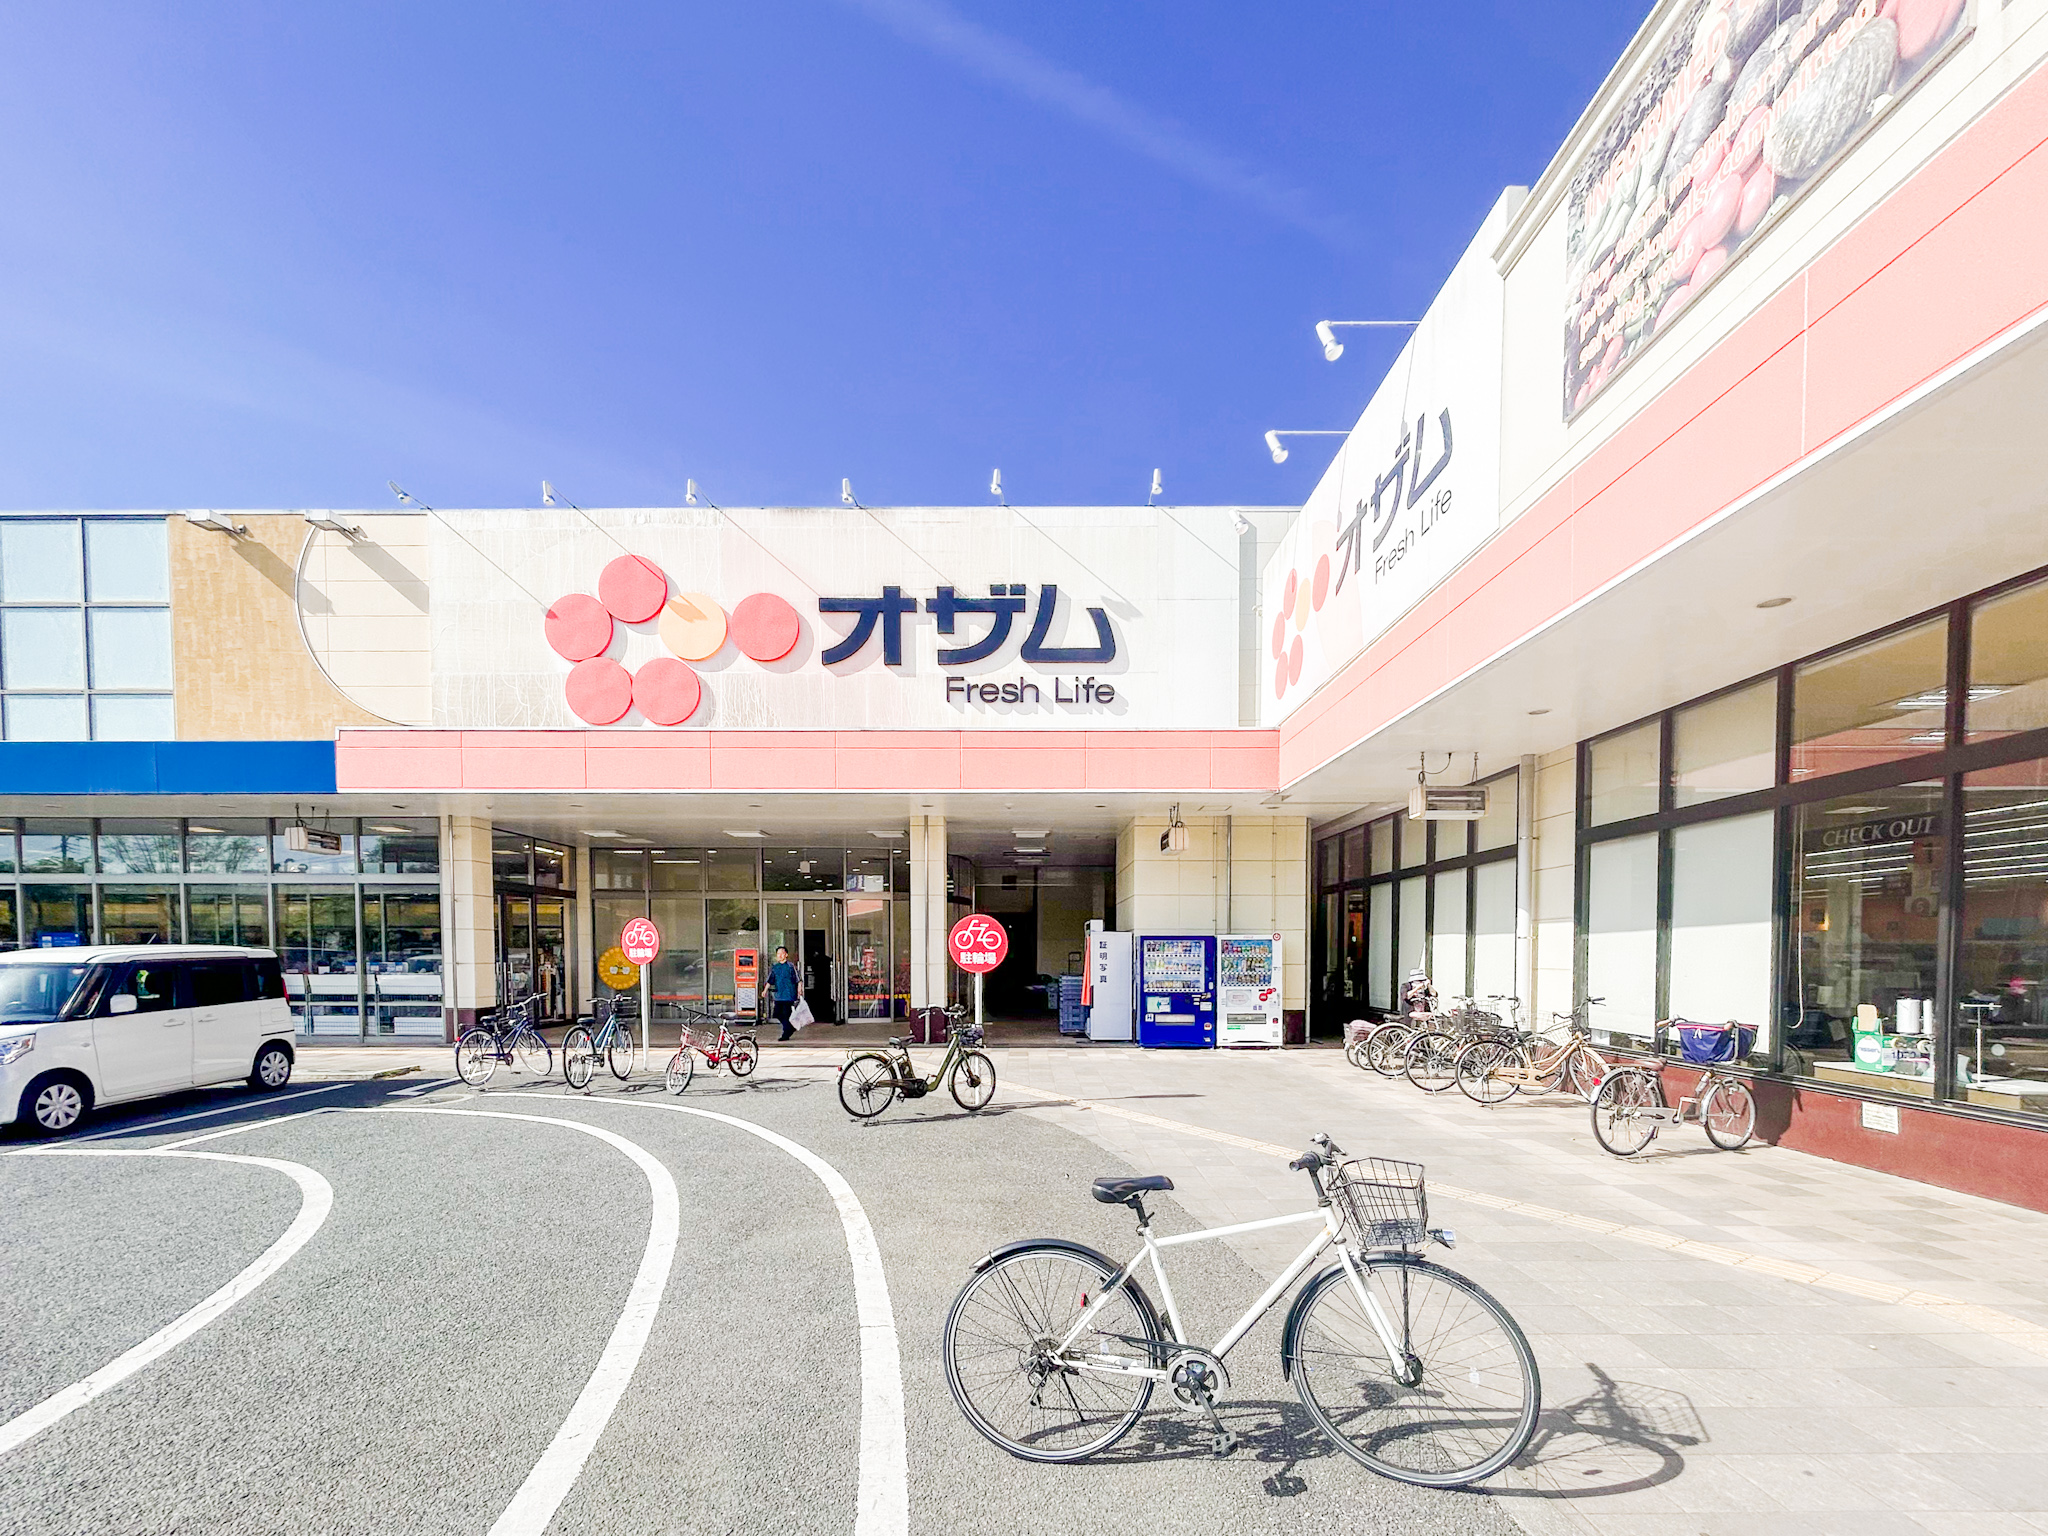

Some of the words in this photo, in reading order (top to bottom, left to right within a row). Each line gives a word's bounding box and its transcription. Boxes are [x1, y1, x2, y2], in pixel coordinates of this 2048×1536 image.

[1584, 18, 1728, 230] INFORMED
[1615, 190, 1663, 262] team
[1669, 47, 1783, 206] members
[1579, 279, 1643, 370] serving
[1648, 239, 1693, 302] you.
[1336, 407, 1453, 596] オザム
[1375, 527, 1415, 585] Fresh
[1421, 489, 1453, 537] Life
[818, 584, 1116, 665] オザム
[946, 676, 1040, 703] Fresh
[1055, 676, 1116, 704] Life
[1822, 823, 1885, 847] CHECK
[1888, 815, 1936, 838] OUT
[628, 947, 653, 958] 駐輪場
[959, 951, 997, 965] 駐輪場
[1099, 940, 1108, 984] 証明写真
